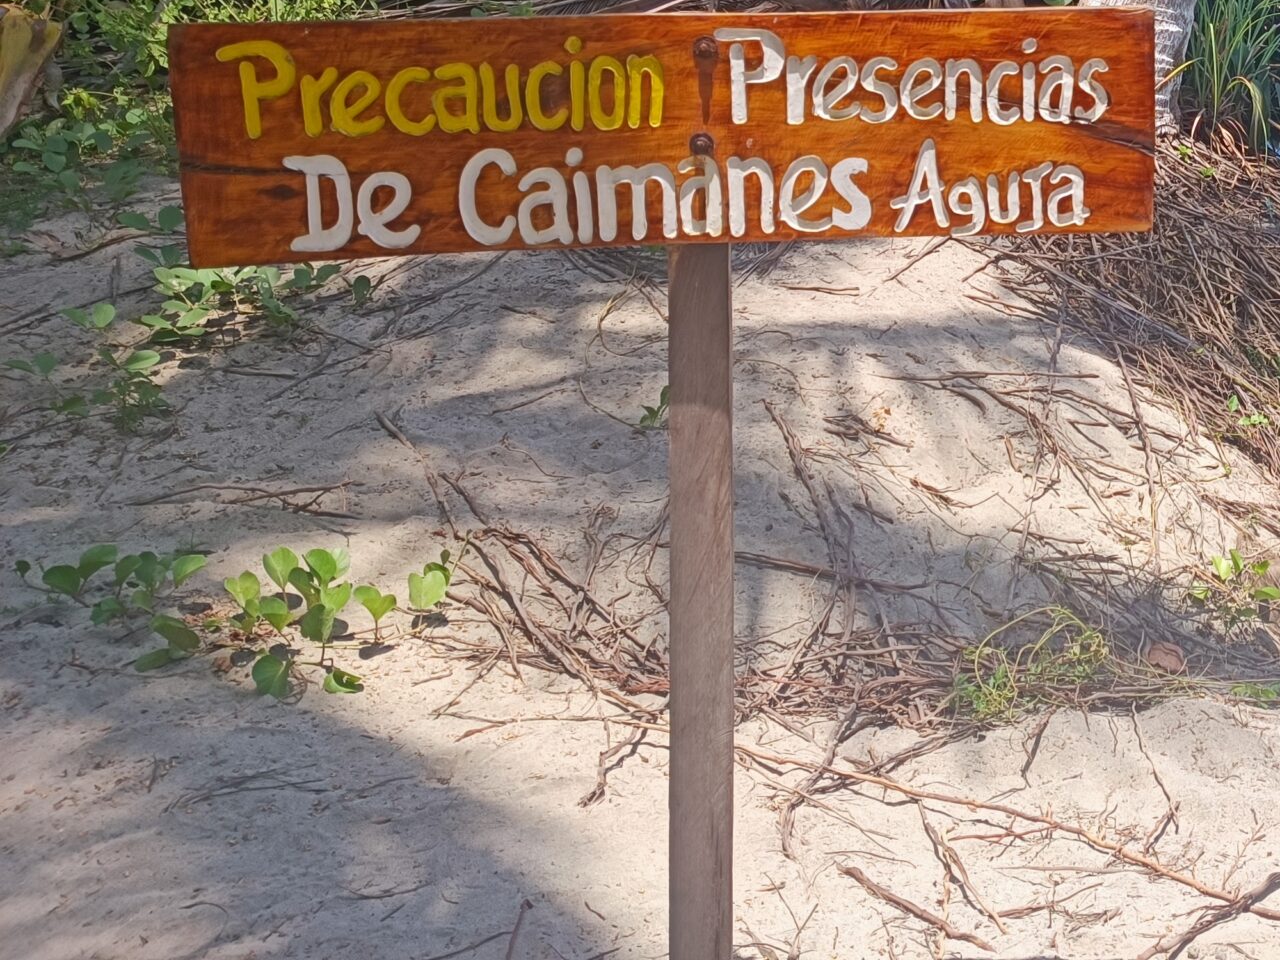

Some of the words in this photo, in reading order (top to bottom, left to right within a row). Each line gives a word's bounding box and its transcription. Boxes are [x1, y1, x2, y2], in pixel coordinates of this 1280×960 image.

[215, 36, 665, 139] Precaucion
[714, 27, 1109, 125] Presencias
[282, 154, 422, 252] De
[458, 148, 872, 245] Caimanes
